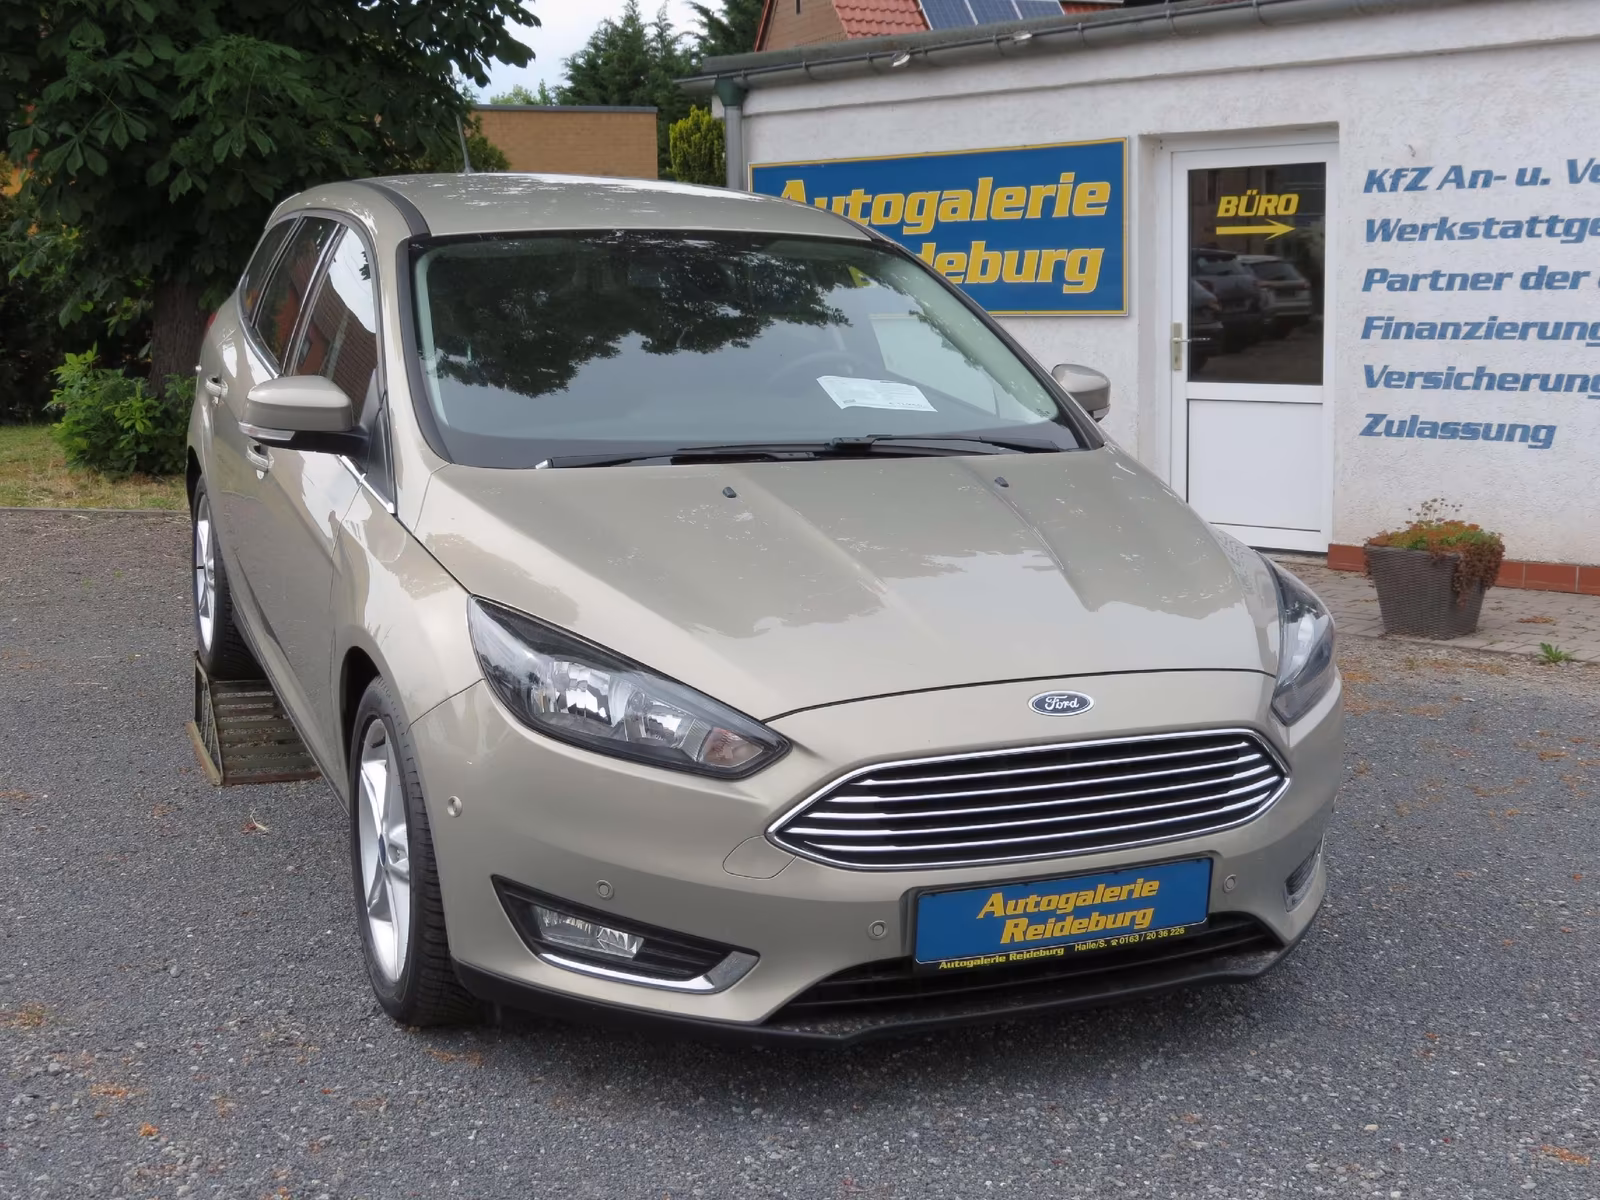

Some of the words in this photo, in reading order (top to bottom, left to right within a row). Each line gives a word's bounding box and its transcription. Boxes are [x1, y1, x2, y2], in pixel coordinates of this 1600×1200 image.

[1363, 166, 1434, 193] KfZ
[1436, 165, 1507, 191] An-
[1515, 166, 1551, 187] u.
[1216, 189, 1299, 217] BÜRO
[1362, 267, 1513, 292] Partner
[1519, 265, 1591, 291] der
[1359, 413, 1557, 449] Zulassung
[1044, 695, 1079, 711] Ford
[976, 878, 1160, 919] Autogalerie
[1000, 908, 1155, 944] Reideburg
[939, 955, 1006, 969] Autogalerie
[1009, 947, 1065, 961] Reideburg
[1074, 939, 1108, 952] Halle/S.
[1119, 935, 1140, 944] 0163
[1146, 931, 1157, 940] 20
